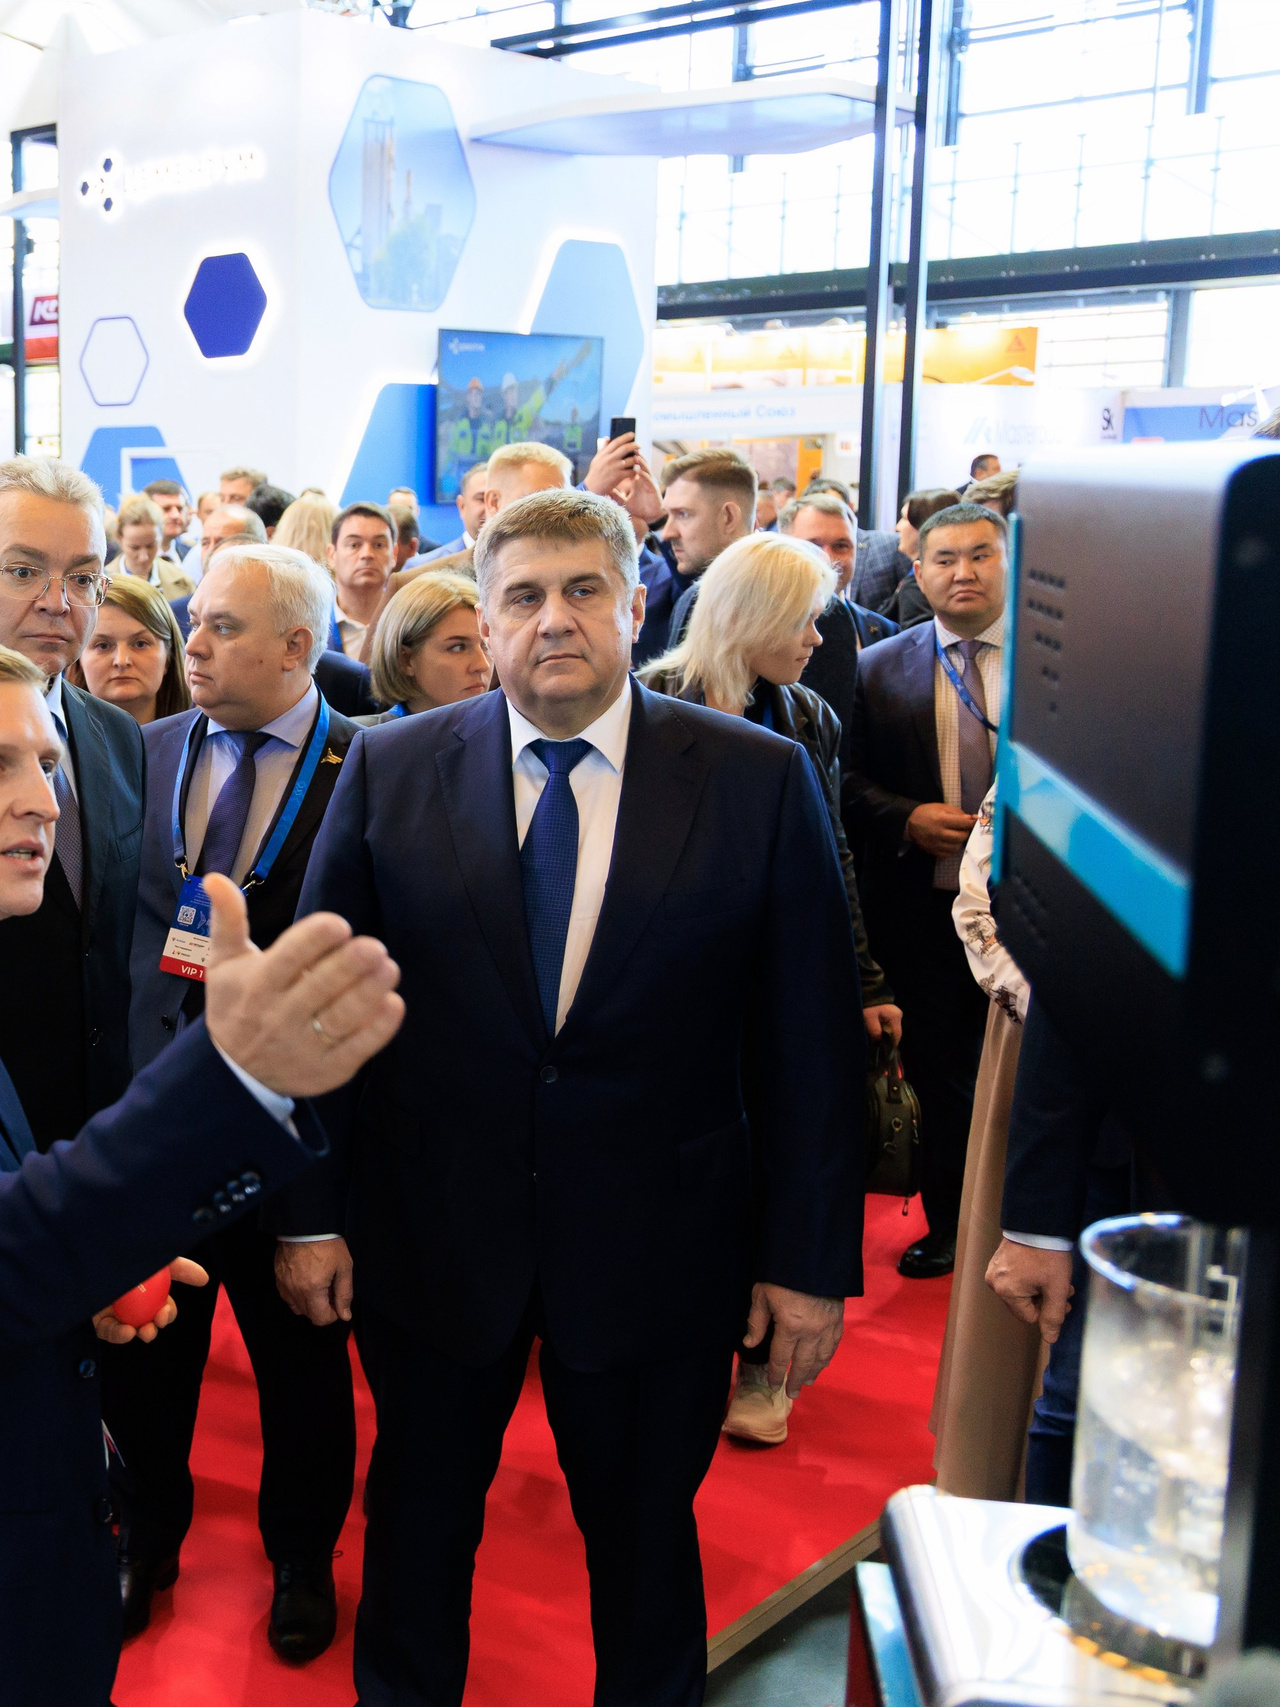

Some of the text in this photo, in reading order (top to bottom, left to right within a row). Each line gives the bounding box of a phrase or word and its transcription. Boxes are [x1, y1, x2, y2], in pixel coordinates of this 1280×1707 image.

[652, 405, 751, 421] омышленный
[1199, 405, 1258, 429] Mas
[181, 965, 198, 977] VIP
